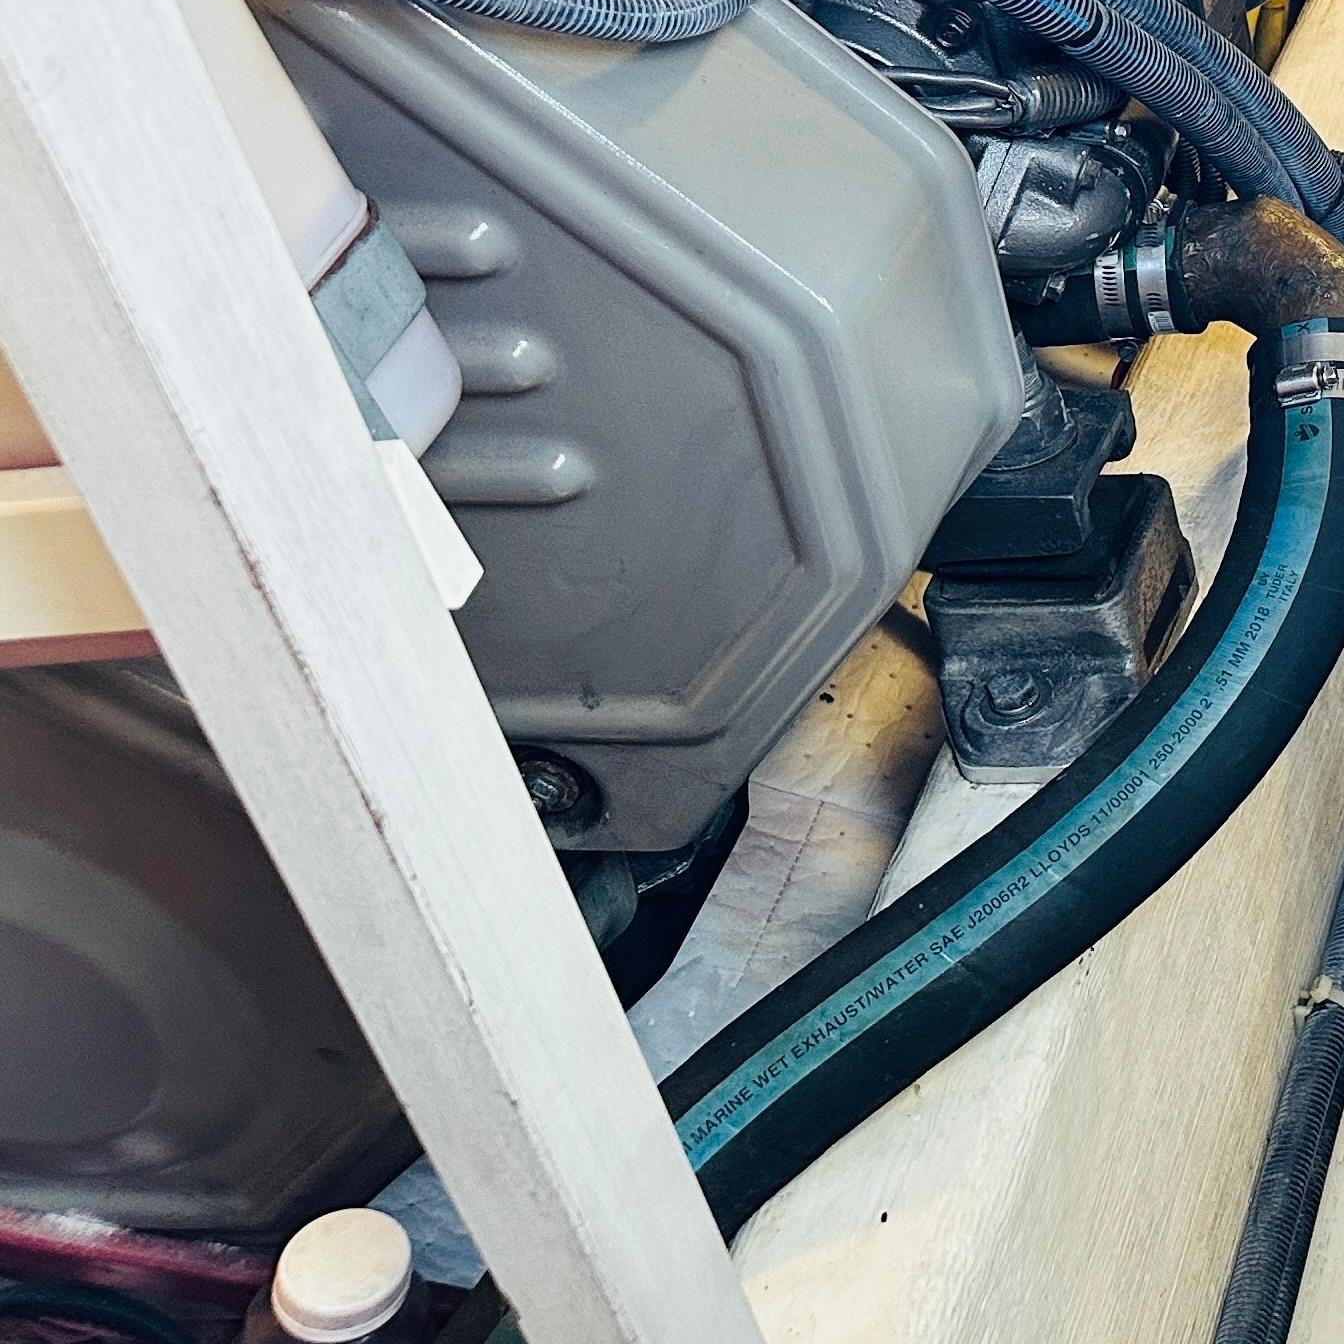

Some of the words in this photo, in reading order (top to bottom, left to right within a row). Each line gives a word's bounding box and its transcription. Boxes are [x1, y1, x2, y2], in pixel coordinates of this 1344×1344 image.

[1258, 571, 1271, 586] BY
[1266, 564, 1289, 599] TUDER
[1279, 570, 1299, 601] ITALY
[692, 1086, 754, 1145] MARINE
[752, 1054, 790, 1089] WET
[791, 952, 930, 1060] EXHAUST/WATER
[930, 924, 965, 956] SAE
[968, 875, 1031, 929] J2006R2
[1029, 824, 1092, 879] LLOYDS
[1089, 768, 1152, 826] 11/00001
[1148, 708, 1204, 771] 250-2000
[1228, 641, 1251, 669] MM
[1245, 606, 1270, 641] 2018
